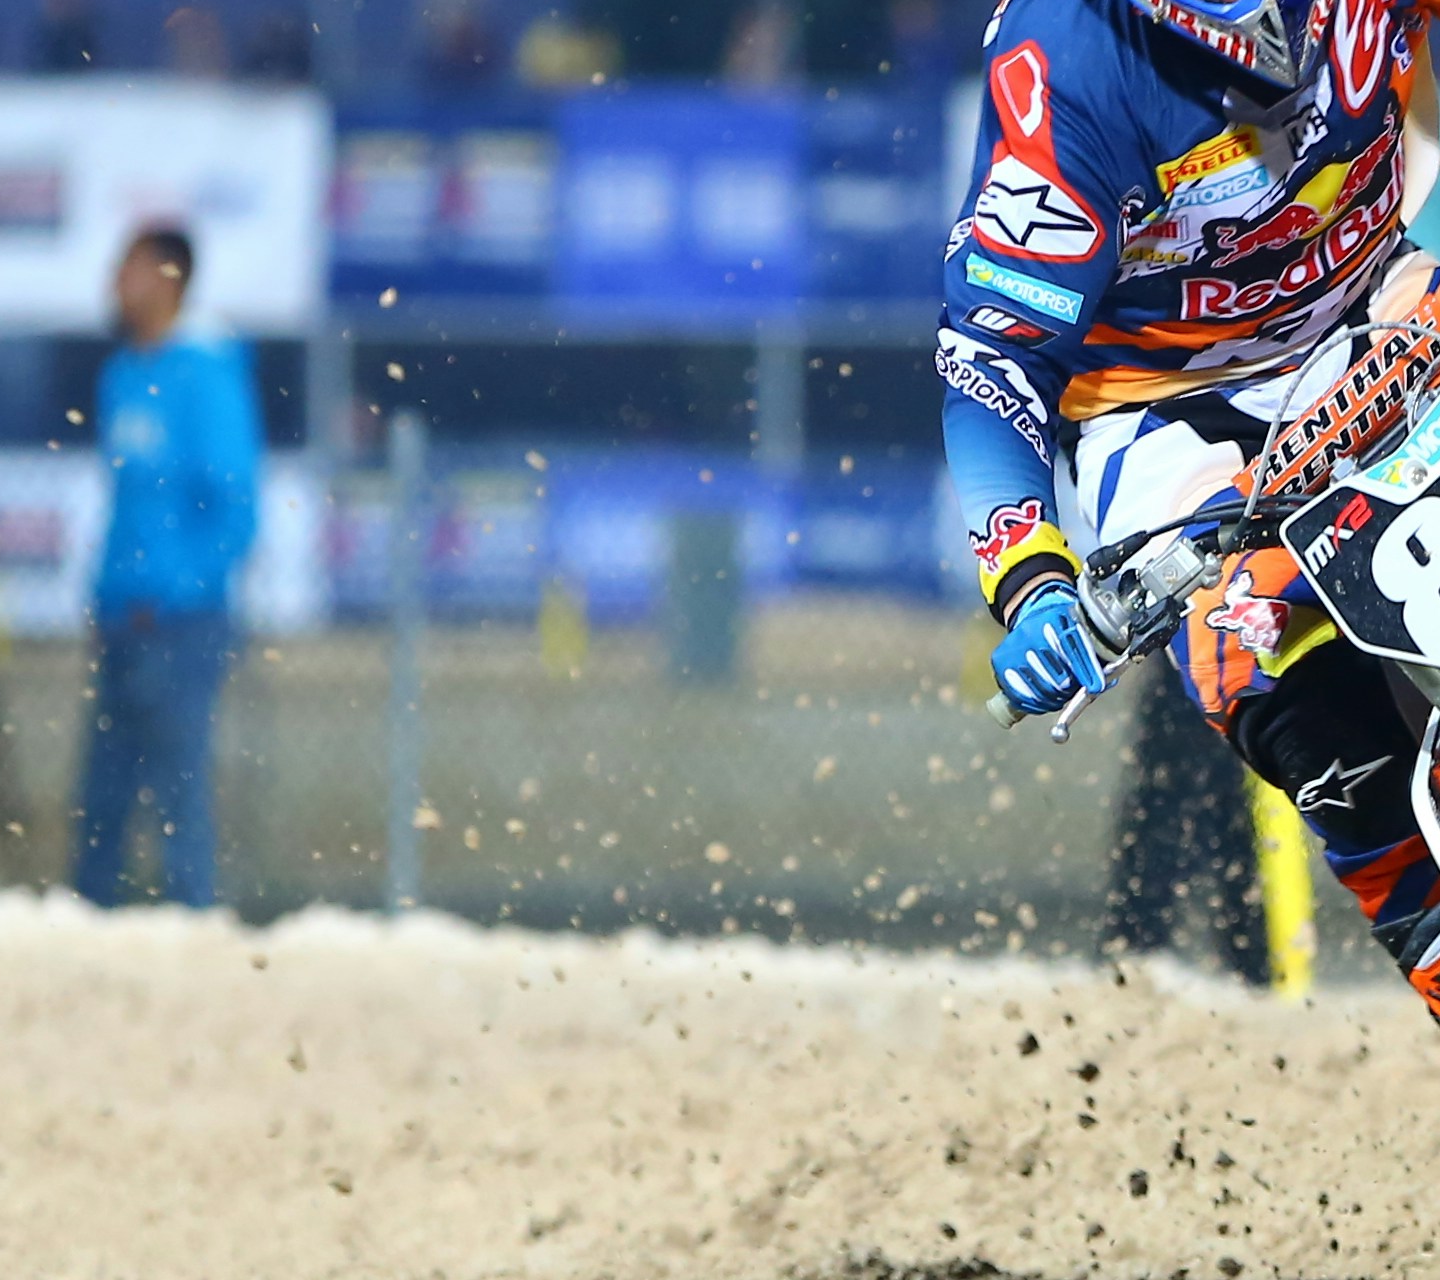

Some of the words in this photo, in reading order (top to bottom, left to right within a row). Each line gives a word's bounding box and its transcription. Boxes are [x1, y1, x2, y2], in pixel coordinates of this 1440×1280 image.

[1169, 166, 1264, 208] OTOREX
[991, 272, 1078, 319] MOTOREX
[1180, 238, 1325, 321] Red
[971, 306, 1043, 339] WP
[934, 345, 1021, 420] ORPION
[1303, 492, 1375, 576] MX2
